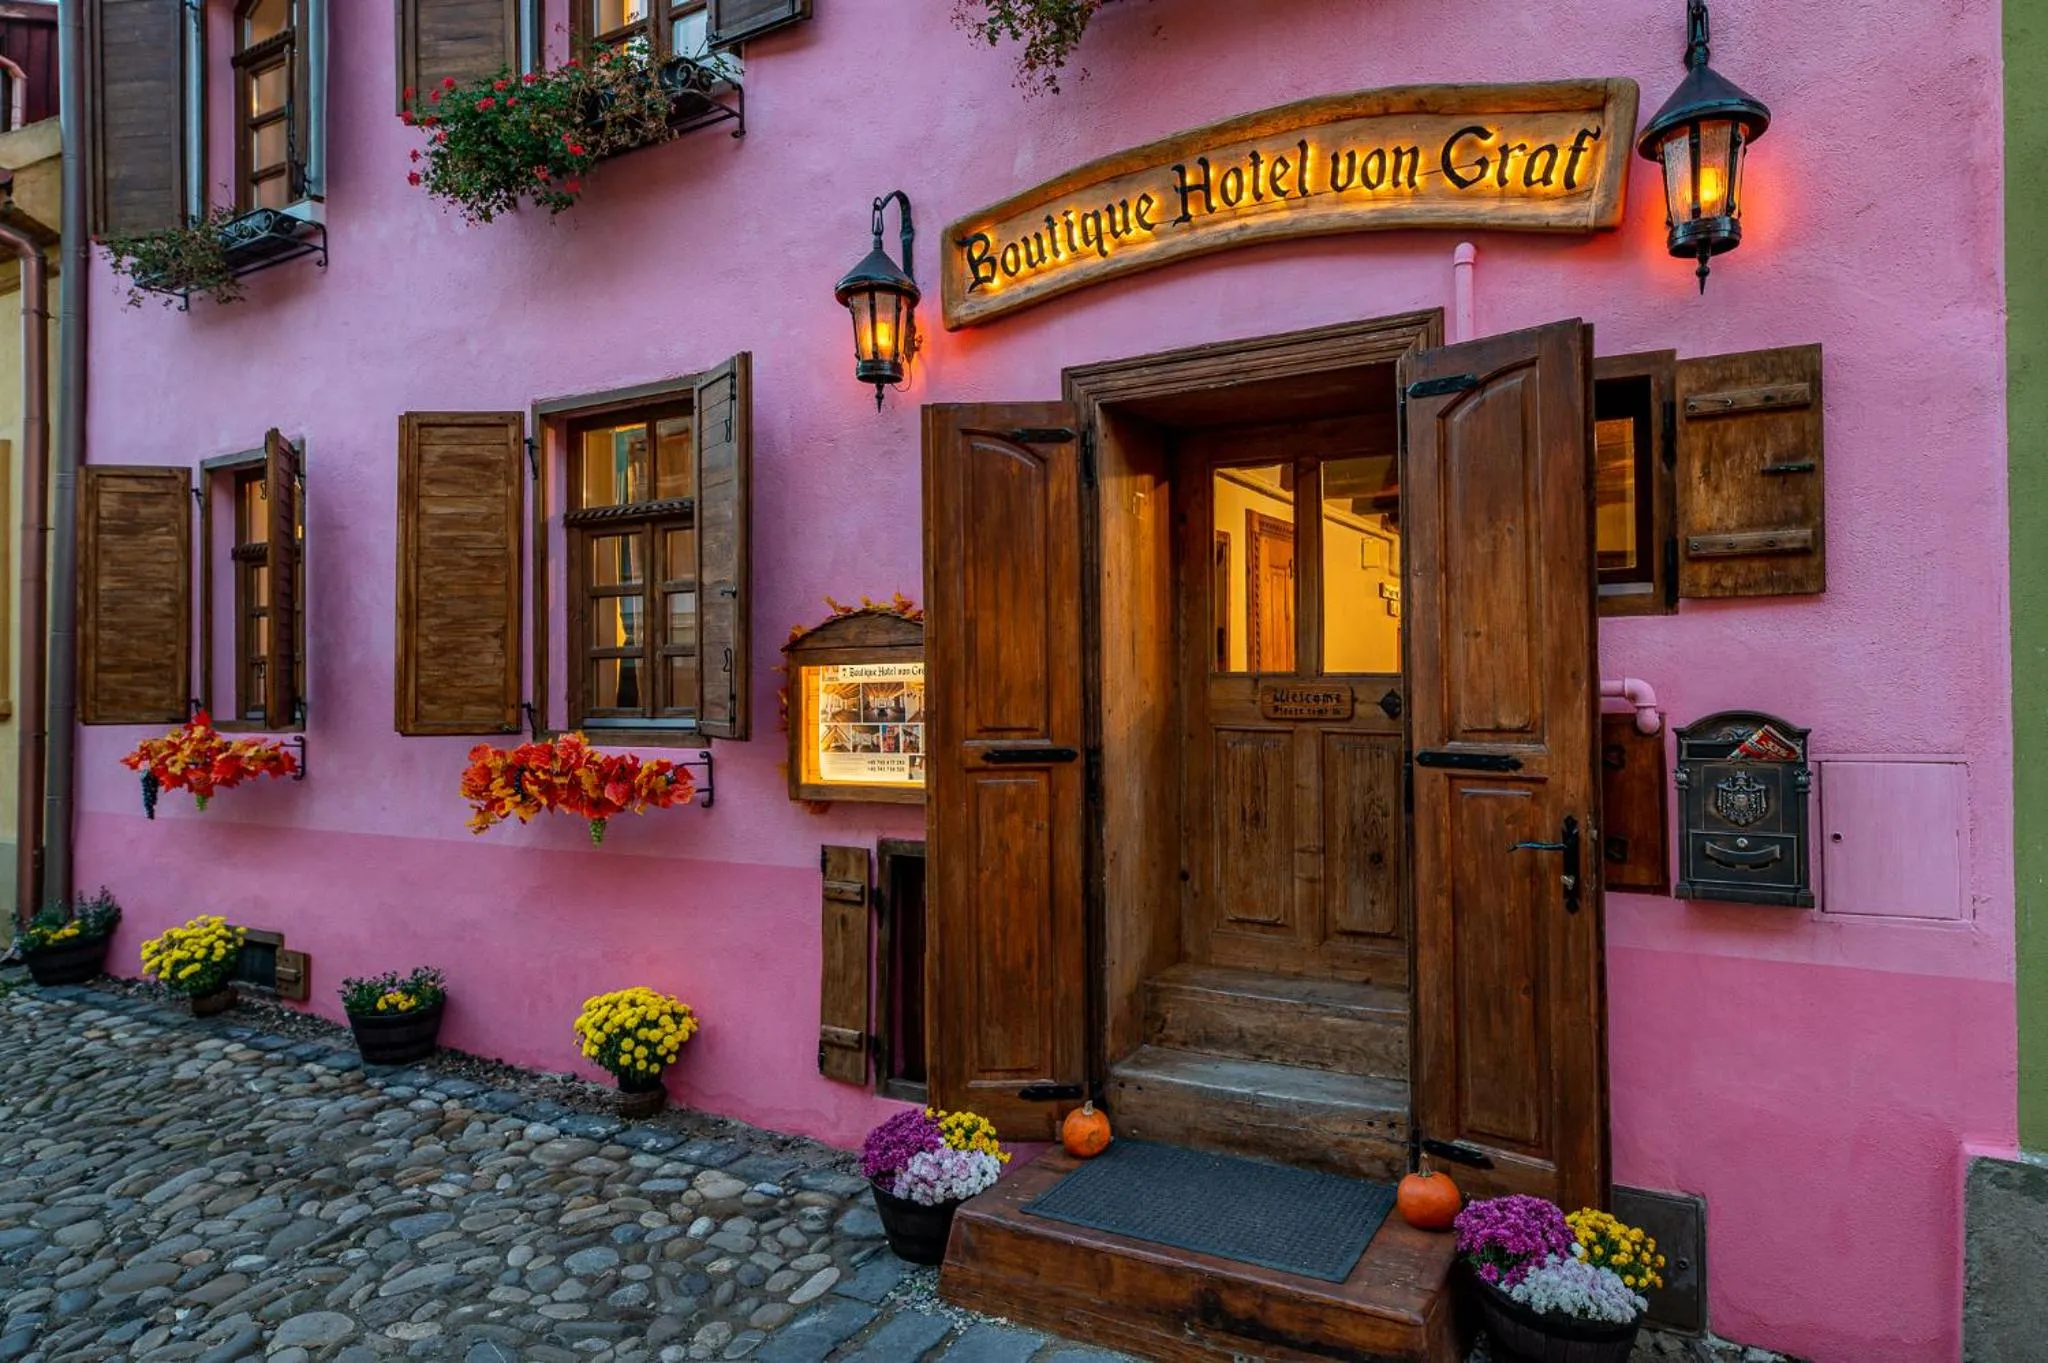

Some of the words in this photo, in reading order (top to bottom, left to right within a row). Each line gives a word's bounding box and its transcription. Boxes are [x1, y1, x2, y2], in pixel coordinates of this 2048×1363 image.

[958, 190, 1155, 293] Boutique
[1172, 139, 1308, 226] Hotel
[1329, 146, 1418, 192] von
[1440, 125, 1602, 190] Graf
[1273, 688, 1341, 704] Welcome
